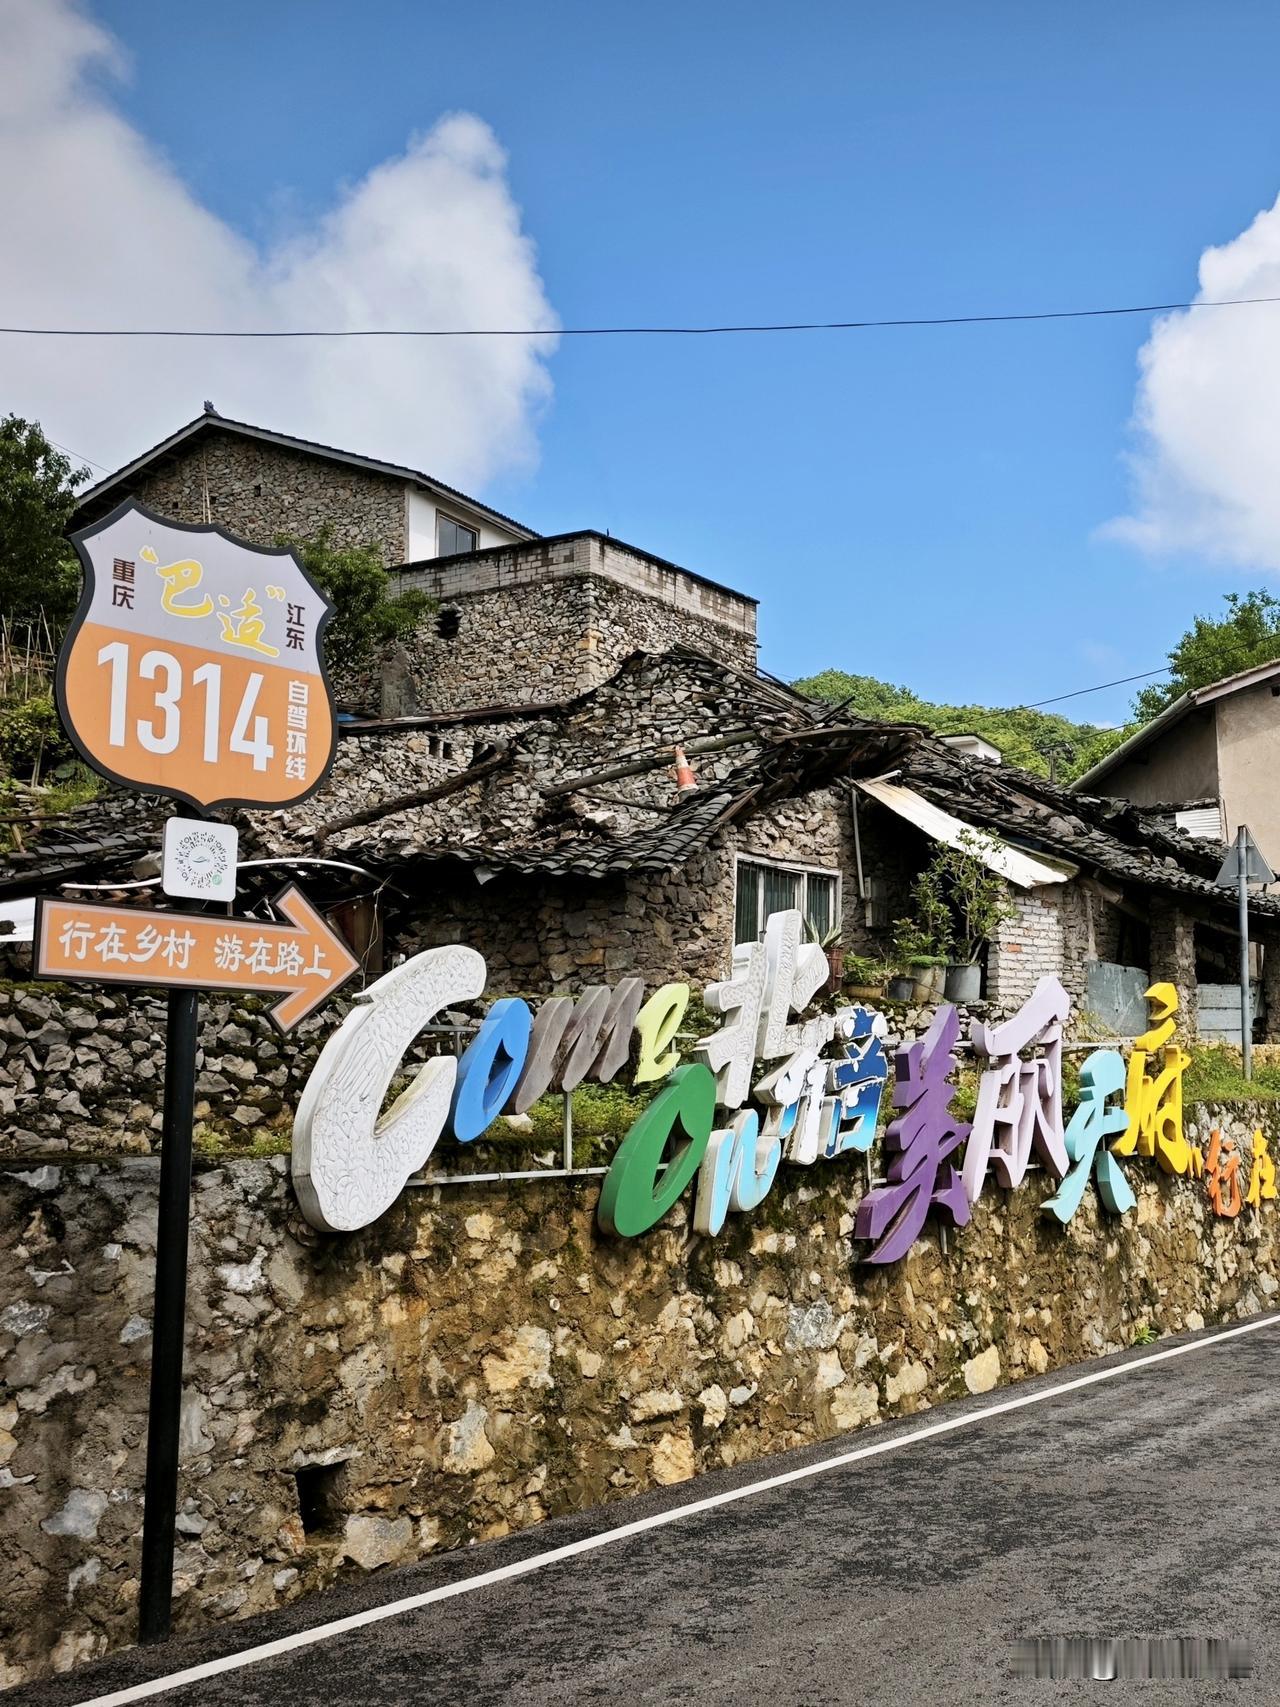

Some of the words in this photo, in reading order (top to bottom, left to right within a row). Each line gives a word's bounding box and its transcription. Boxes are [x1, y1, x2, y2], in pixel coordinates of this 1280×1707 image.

[112, 558, 135, 610] 重庆
[286, 603, 306, 651] 江东
[97, 641, 274, 772] 1314
[285, 680, 310, 781] 自驾环线
[58, 919, 197, 970] 行在乡村
[214, 932, 333, 980] 游在路上
[292, 944, 690, 1233] Come
